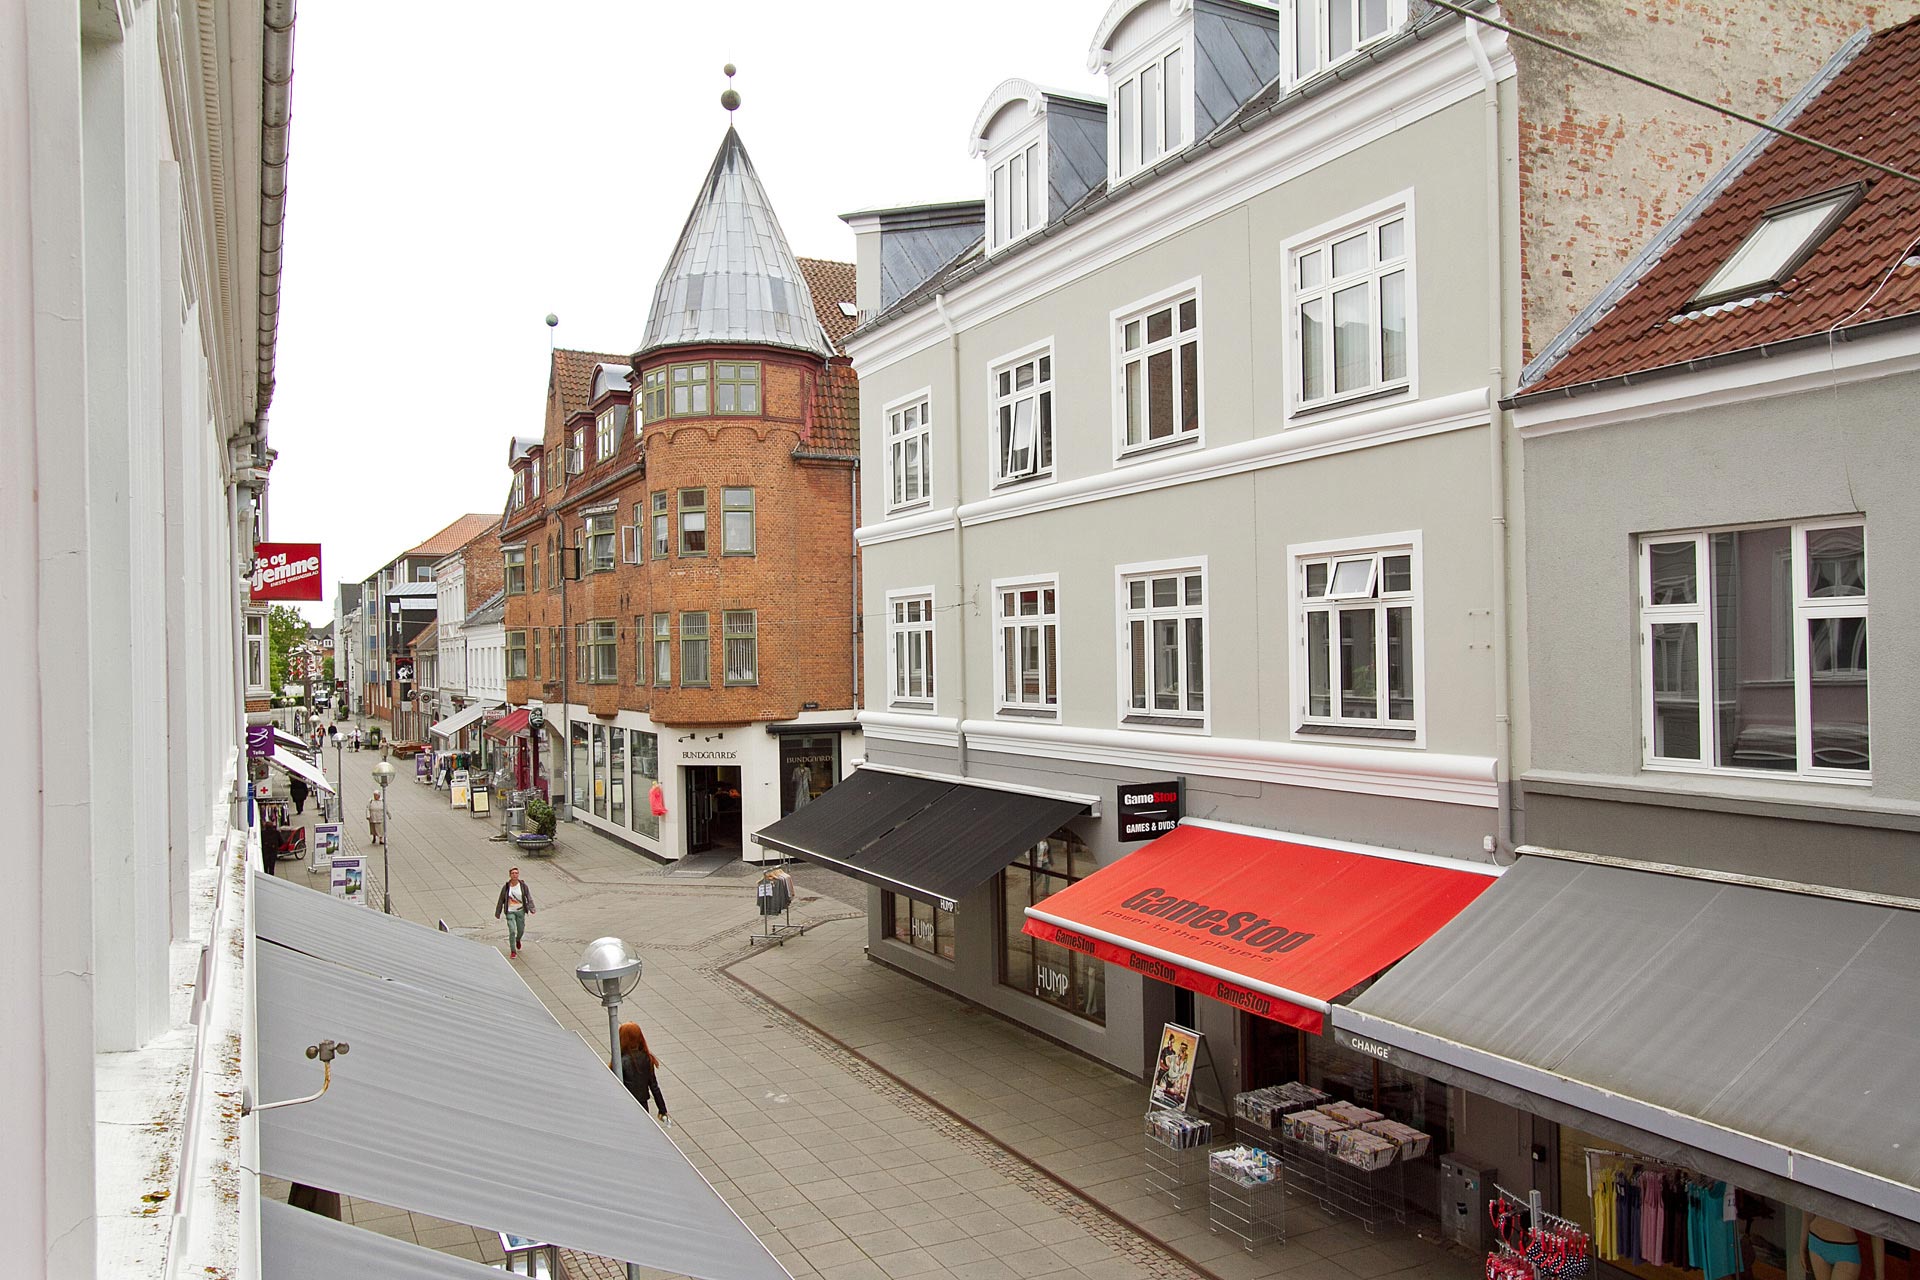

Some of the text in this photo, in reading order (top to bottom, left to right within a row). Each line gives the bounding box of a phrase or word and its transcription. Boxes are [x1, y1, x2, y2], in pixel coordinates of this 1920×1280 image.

[270, 553, 286, 565] og
[682, 751, 737, 759] BUNDGAARDS
[1124, 791, 1177, 805] GameStop
[1126, 820, 1176, 834] GAMES & DVDS
[940, 898, 954, 912] HUMP
[911, 917, 934, 941] HUMP
[1120, 887, 1316, 954] GameStop
[1055, 929, 1096, 954] GameStop
[1102, 910, 1275, 963] power to the players
[1129, 953, 1176, 980] GameStop
[1037, 964, 1069, 996] HUMP
[1216, 982, 1271, 1015] GameStop
[1351, 1037, 1389, 1059] CHANGE
